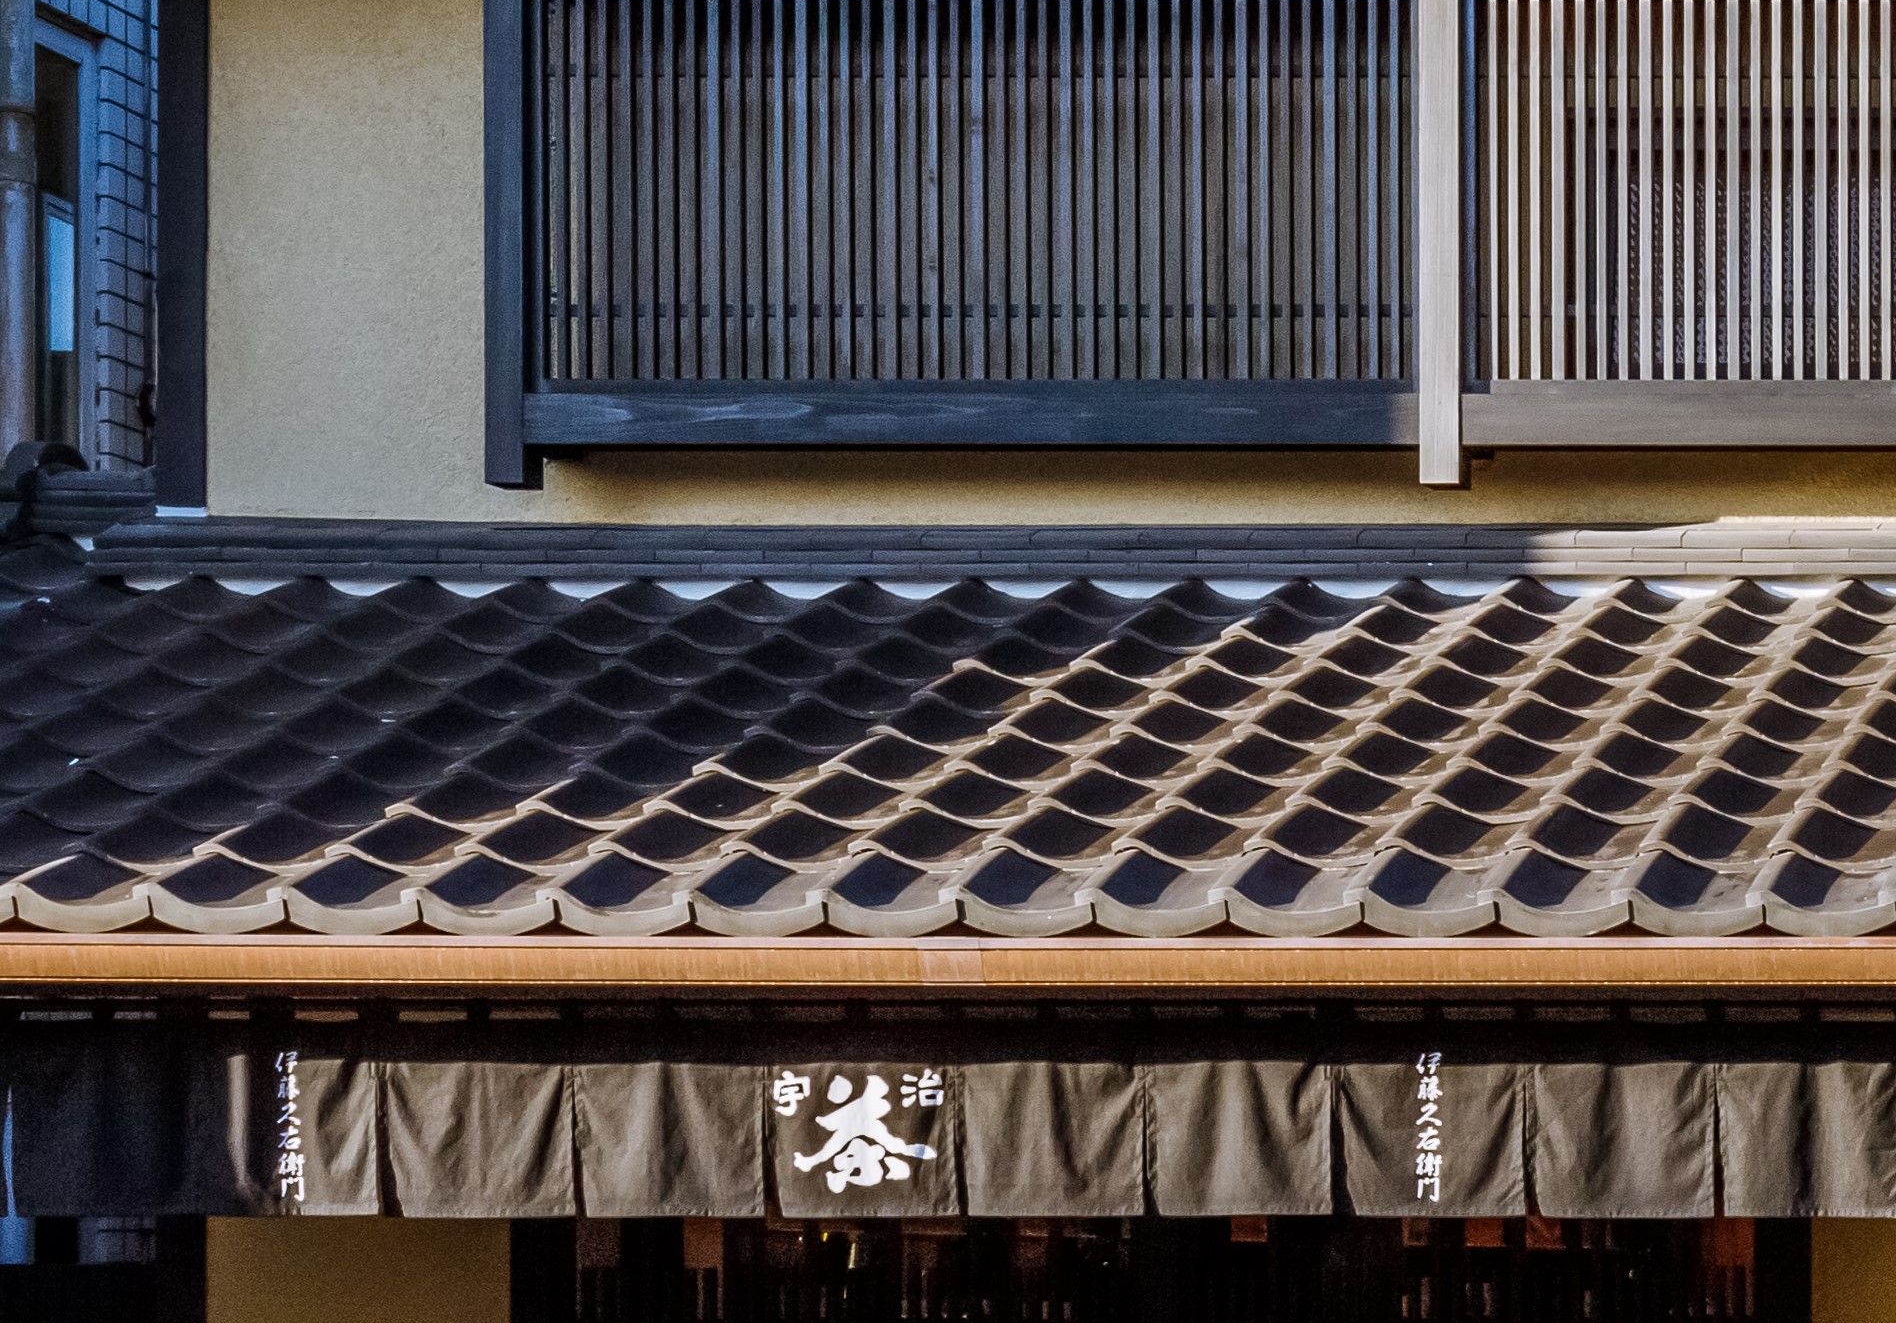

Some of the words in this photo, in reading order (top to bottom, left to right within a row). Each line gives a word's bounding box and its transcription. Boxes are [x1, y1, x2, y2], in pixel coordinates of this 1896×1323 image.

[274, 1050, 306, 1203] 伊藤久右衛門
[792, 1073, 939, 1195] 茶
[1414, 1051, 1444, 1204] 伊藤久右衛門
